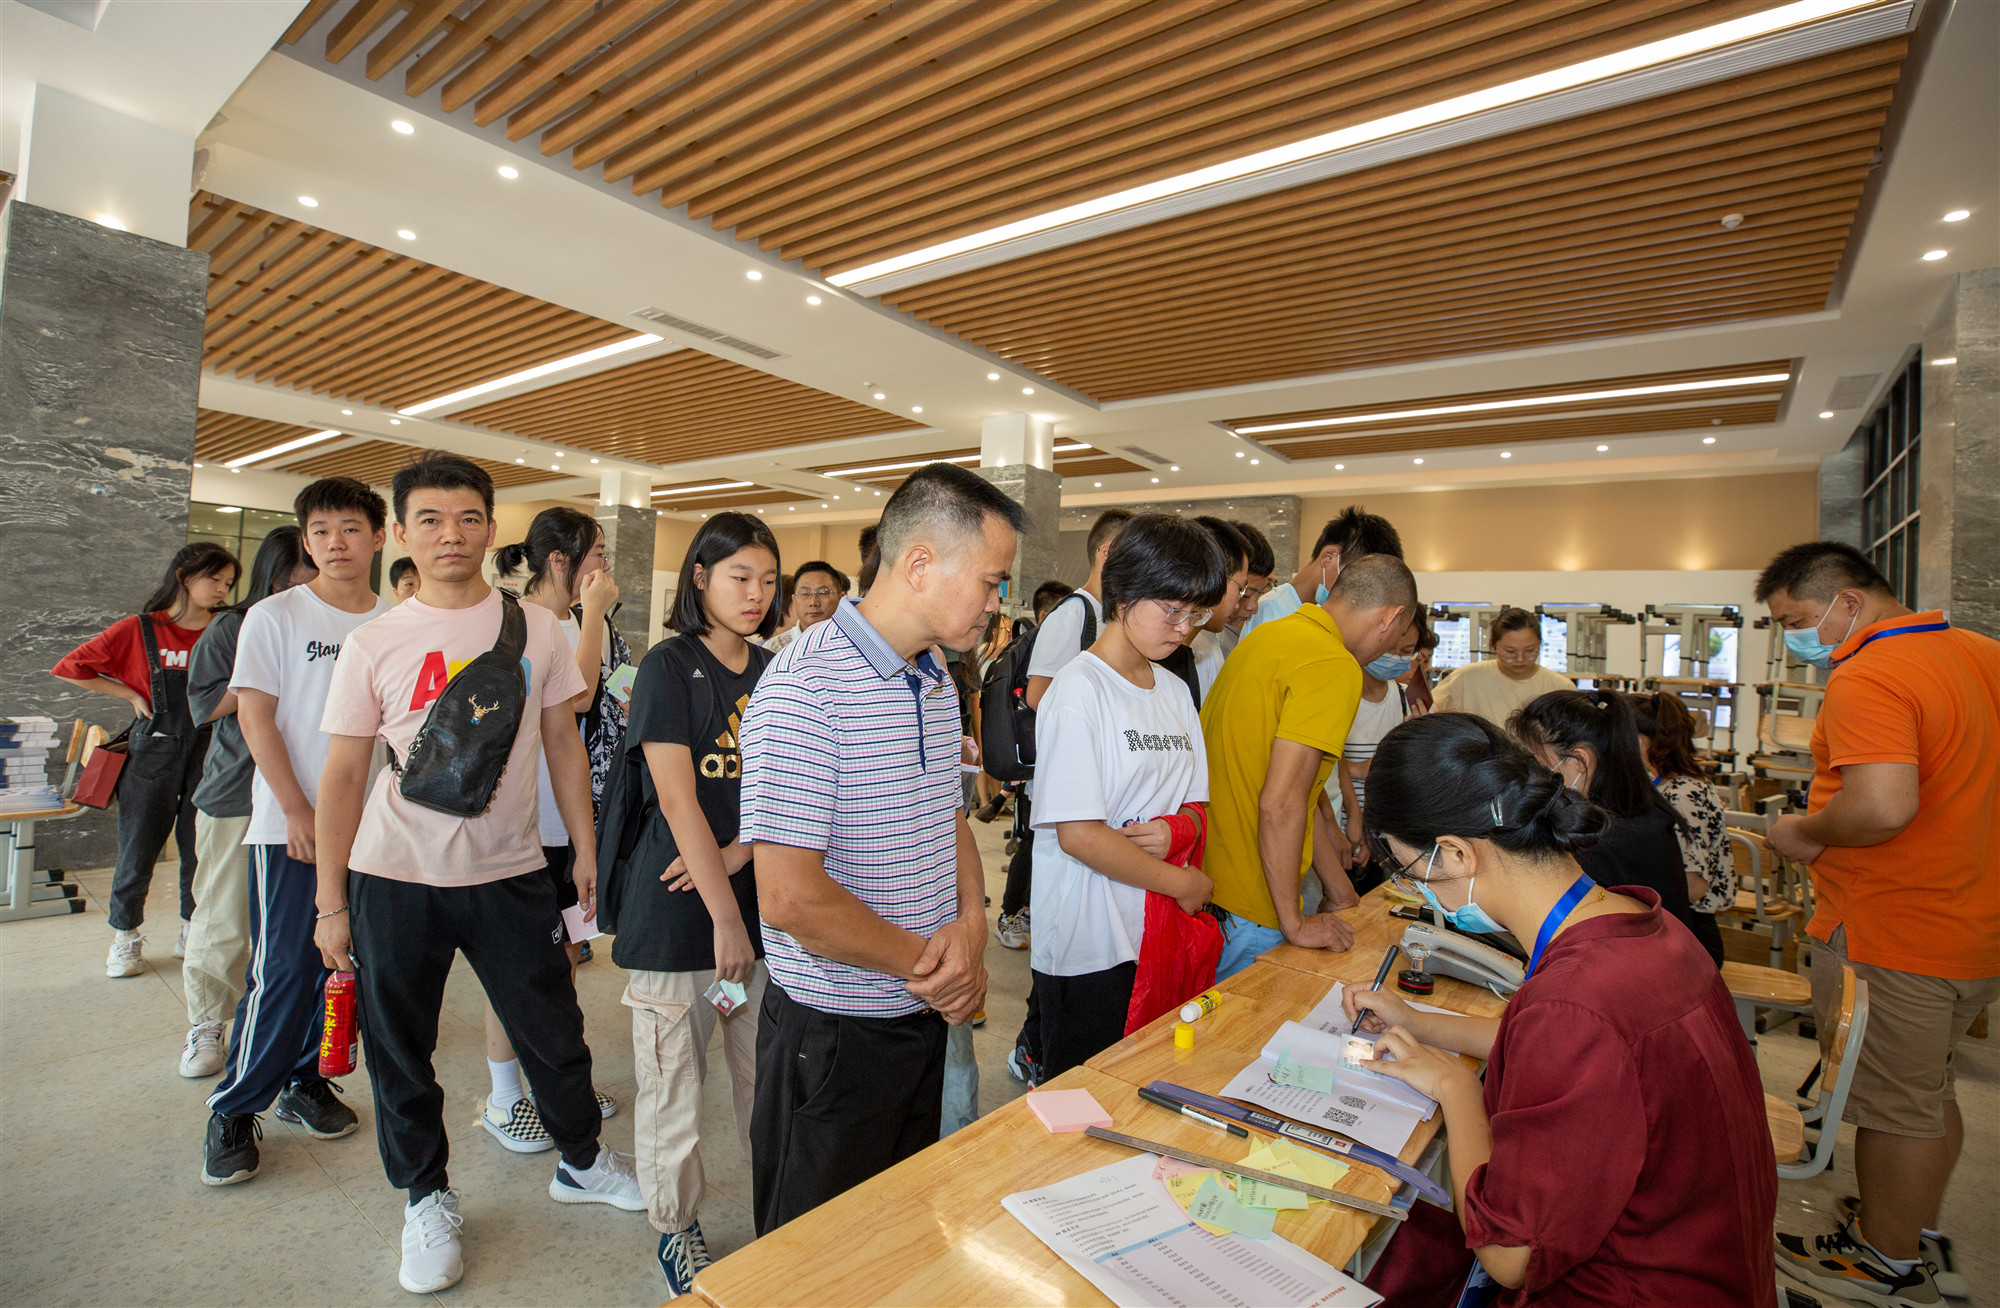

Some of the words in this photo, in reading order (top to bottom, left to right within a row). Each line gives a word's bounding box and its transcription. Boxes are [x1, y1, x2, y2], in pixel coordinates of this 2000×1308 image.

[306, 640, 343, 662] Stay
[321, 999, 336, 1057] 王老吉
